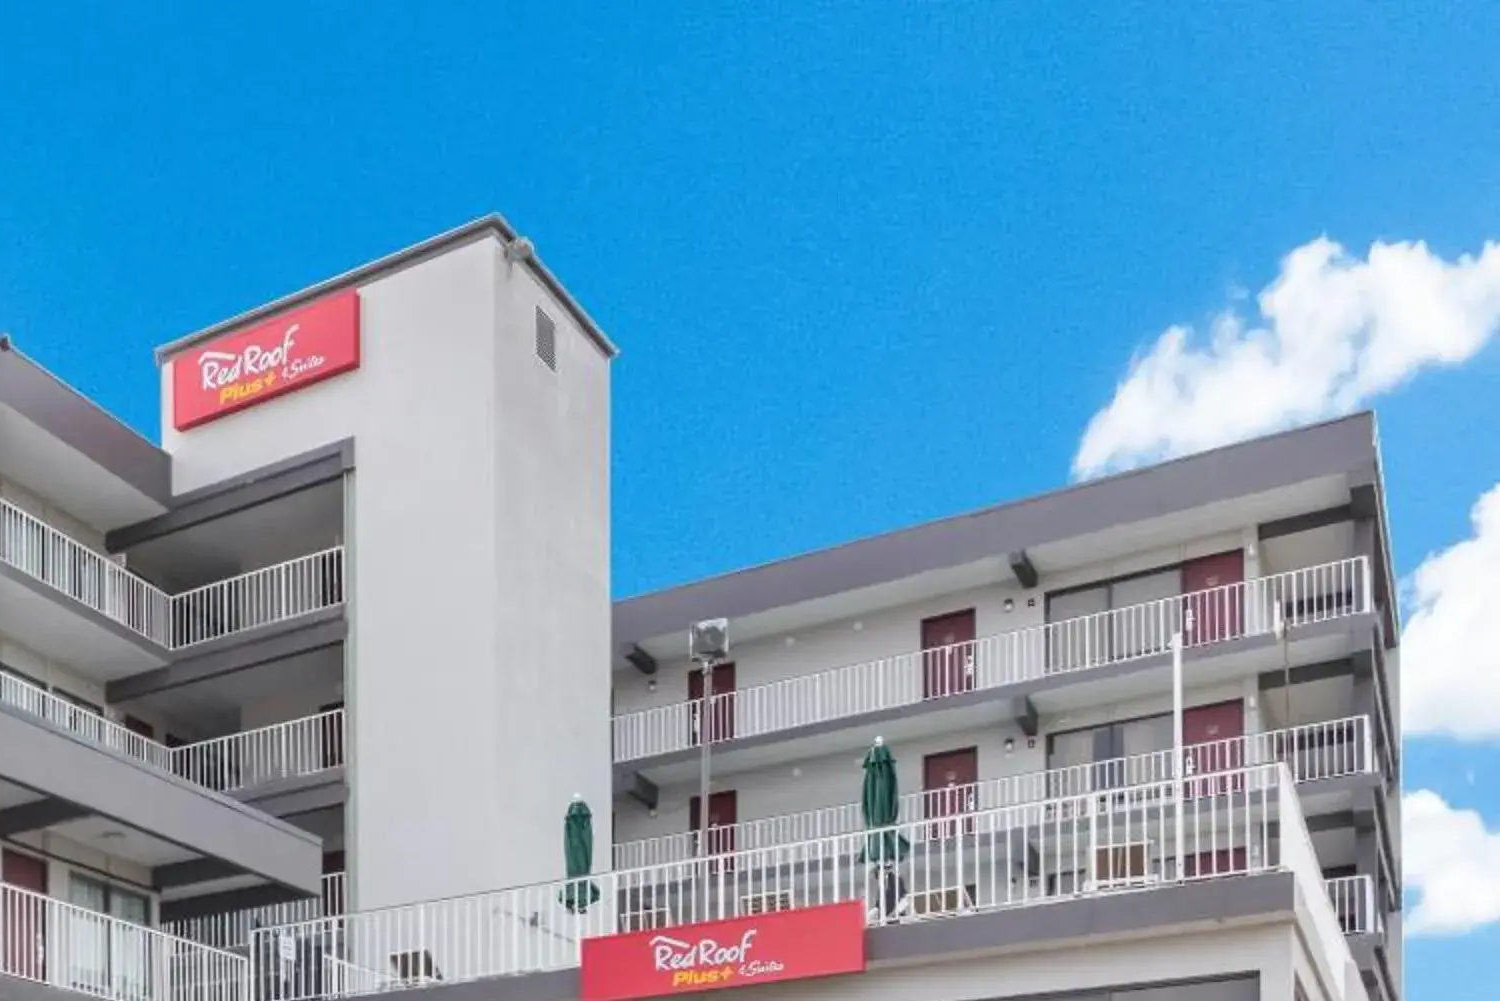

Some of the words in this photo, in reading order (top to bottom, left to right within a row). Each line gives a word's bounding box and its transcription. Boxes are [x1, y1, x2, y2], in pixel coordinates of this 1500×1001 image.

[202, 355, 242, 391] Red
[243, 323, 300, 374] Roof
[655, 945, 697, 971] Red
[699, 929, 757, 965] Roof
